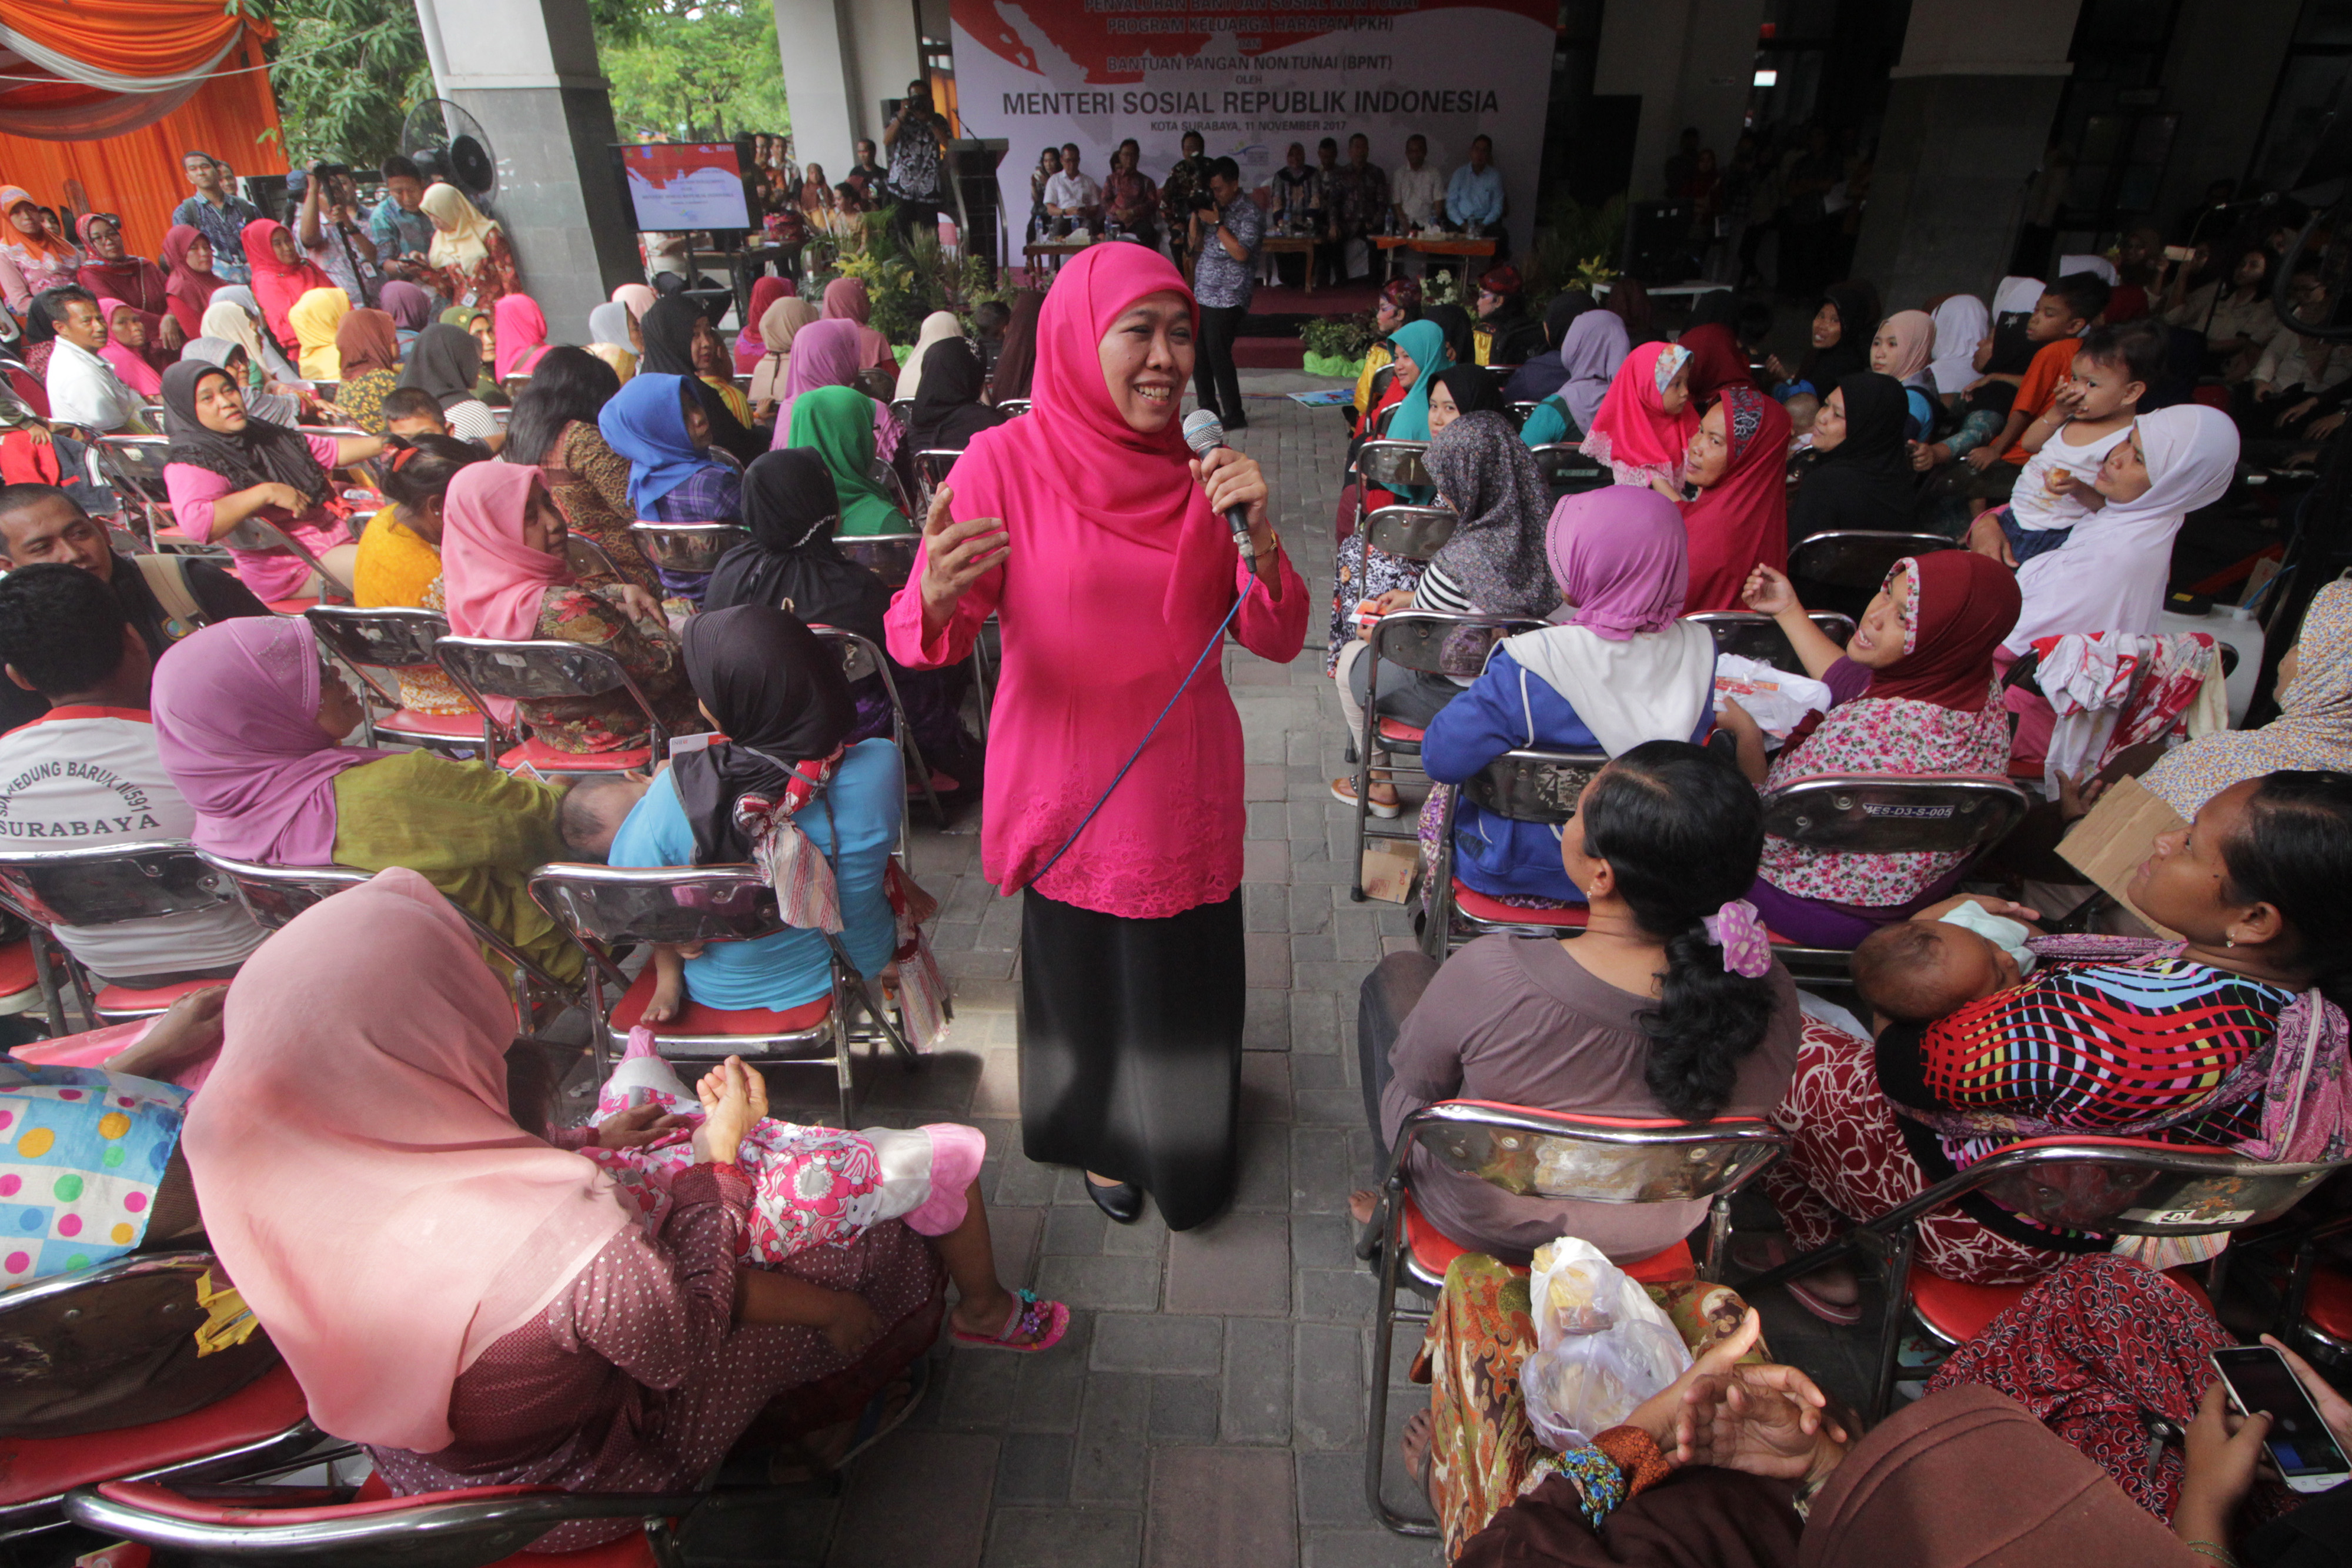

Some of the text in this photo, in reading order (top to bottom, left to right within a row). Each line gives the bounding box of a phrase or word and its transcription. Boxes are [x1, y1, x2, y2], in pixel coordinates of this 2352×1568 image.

[1108, 16, 1393, 32] PROGRAM KELUARGA HARAPAN (PKH)
[1238, 39, 1260, 48] DAN
[1108, 55, 1392, 71] BANTUAN PANGAN NON TUNAI (BPNT)
[1236, 75, 1262, 85] OLEH
[1003, 90, 1498, 115] MENTERI SOSIAL REPUBLIK INDONESIA
[1151, 121, 1178, 131] KOTA
[1245, 122, 1255, 131] 11
[1258, 121, 1319, 131] NOVEMBER
[1322, 121, 1347, 131] 2017
[6, 761, 61, 795] KEDUNG
[66, 761, 122, 788] BARUK
[0, 814, 161, 837] SURABAYA
